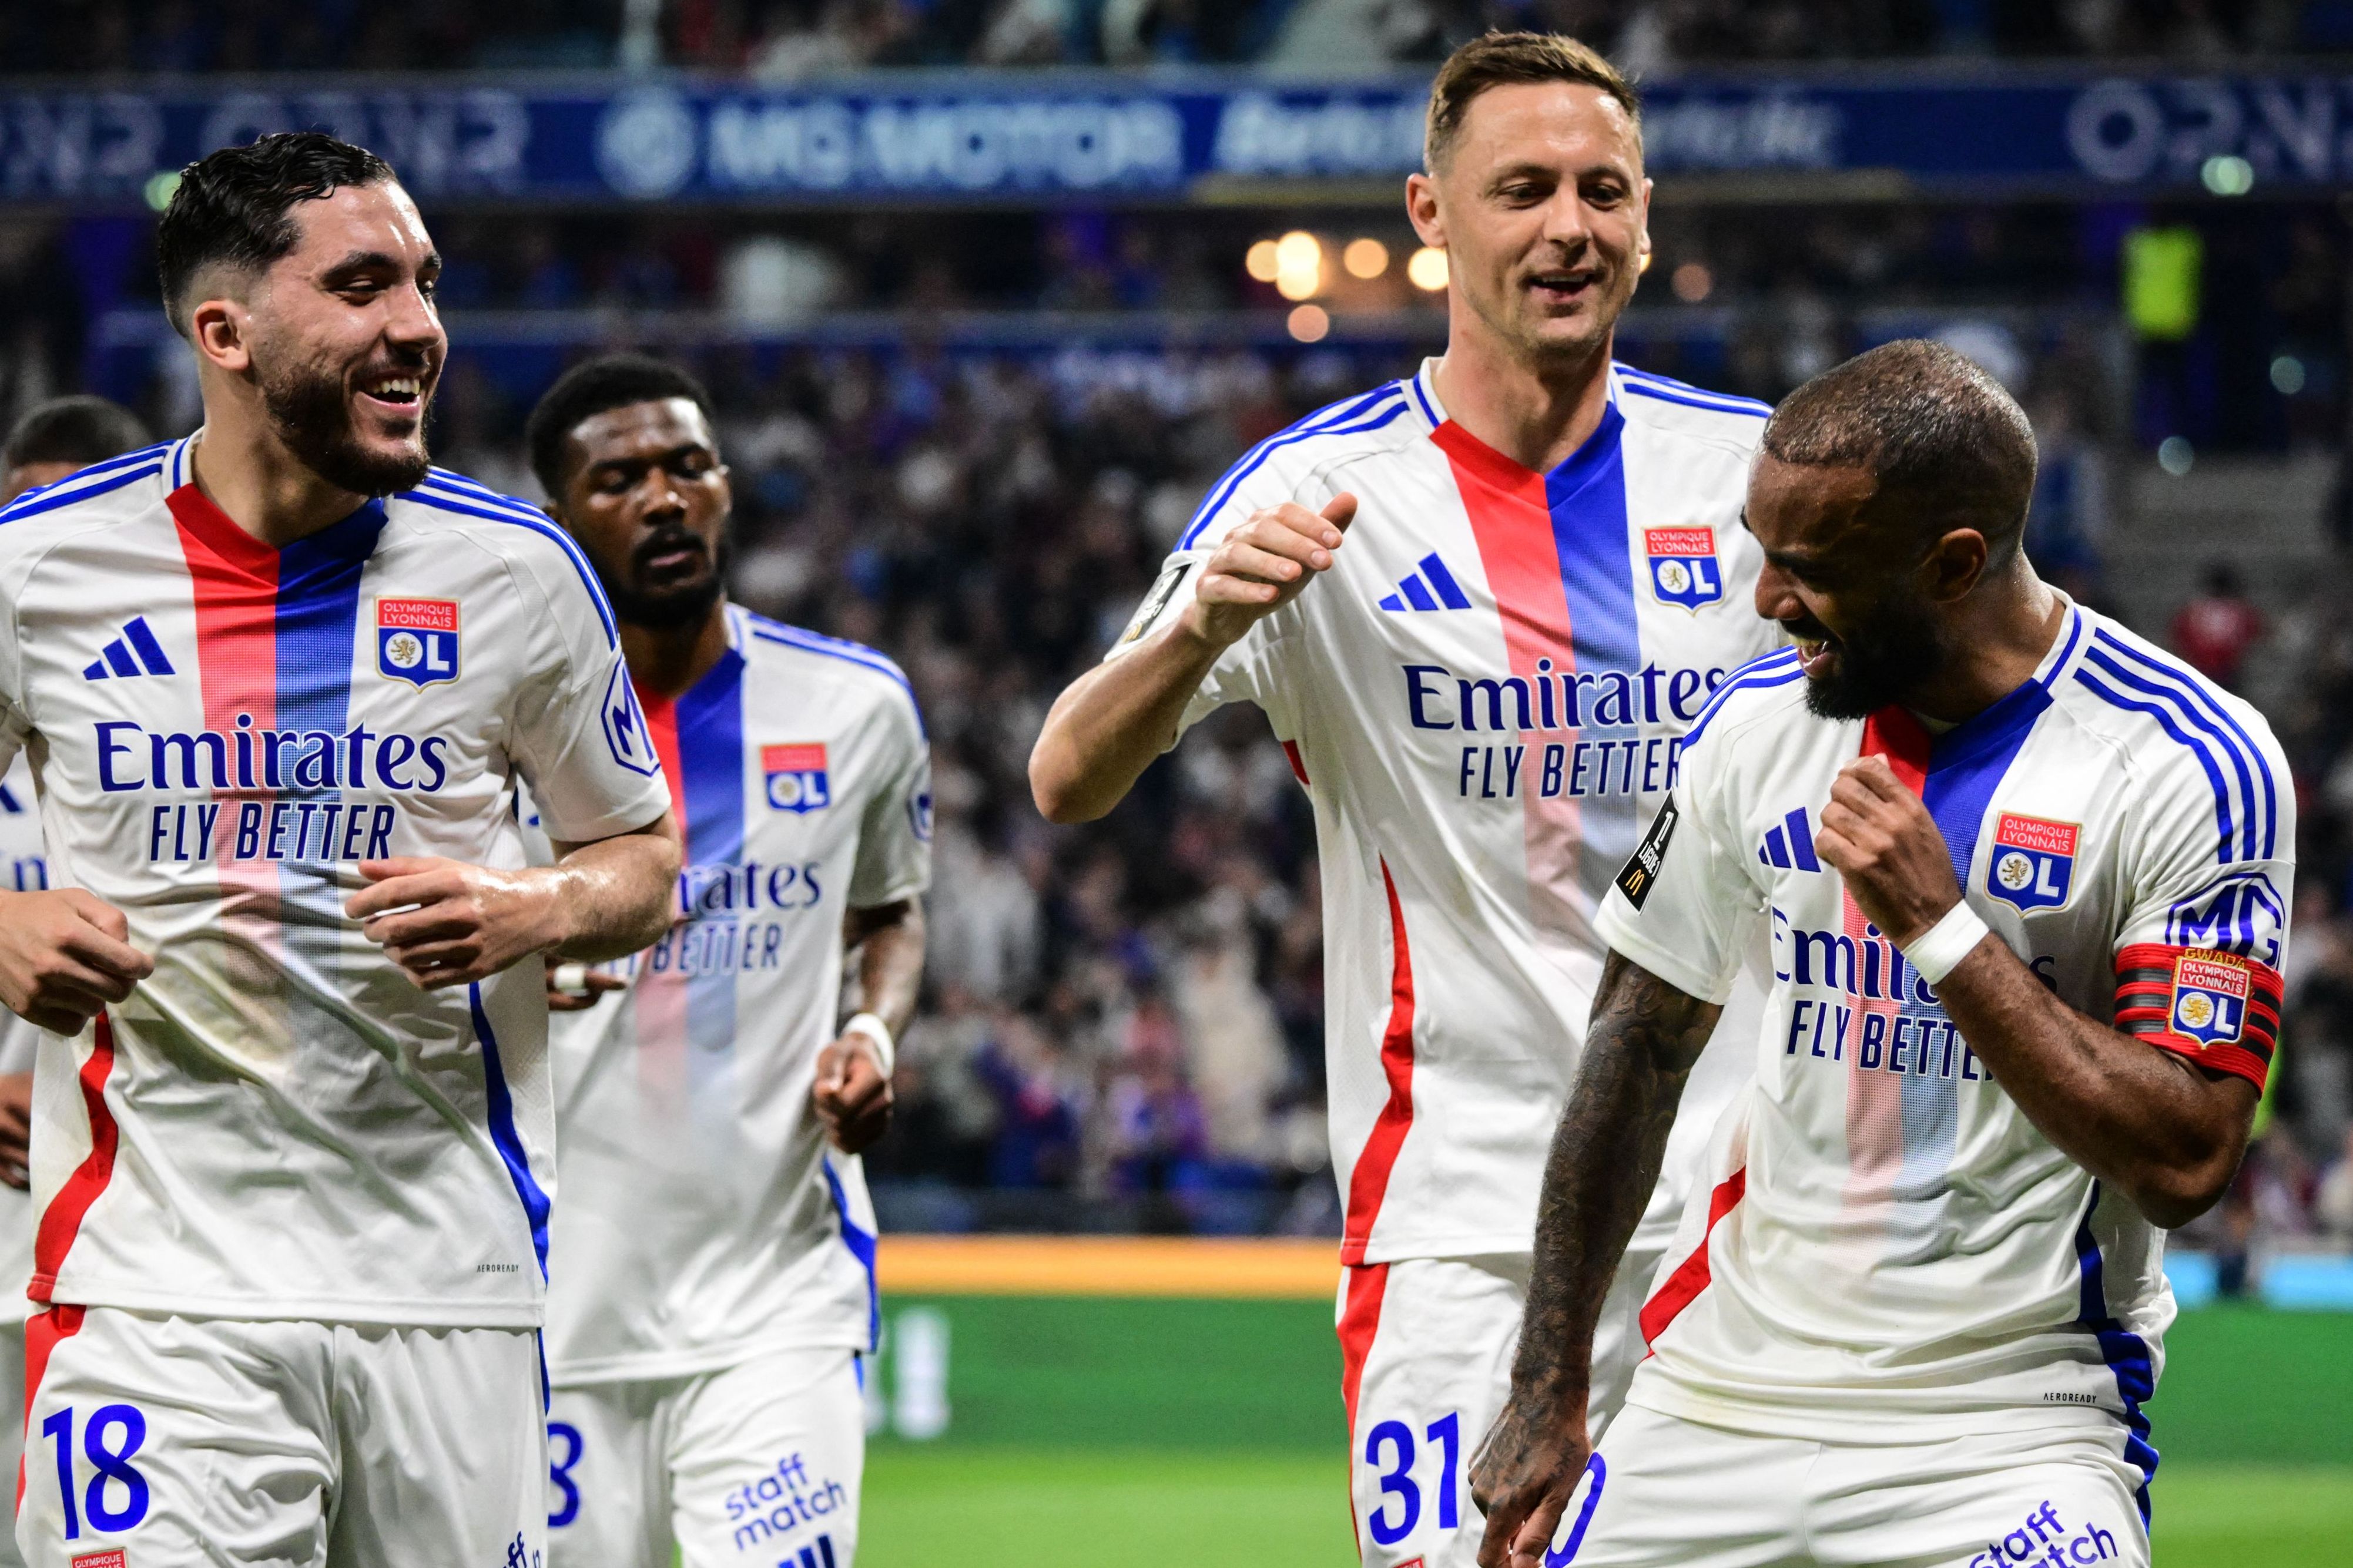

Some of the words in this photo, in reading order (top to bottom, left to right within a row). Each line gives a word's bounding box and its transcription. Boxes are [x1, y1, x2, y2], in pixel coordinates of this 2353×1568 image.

[1649, 532, 1709, 543] OLYMPIQUE
[1651, 542, 1710, 553] LYONNAIS
[1657, 559, 1716, 595] OL
[383, 602, 452, 616] OLYMPIQUE
[383, 613, 452, 627] LYONNAIS
[385, 632, 450, 671] OL
[93, 713, 448, 793] Emirates
[770, 772, 826, 807] OL
[1460, 746, 1524, 798] FLY
[150, 804, 220, 861] FLY
[235, 803, 395, 861] BETTER
[2002, 830, 2070, 851] LYONNAIS
[2005, 818, 2072, 839] OLYMPIQUE
[680, 860, 822, 912] rates
[1996, 851, 2060, 898] OL
[2183, 962, 2245, 983] OLYMPIQUE
[2184, 948, 2245, 970] GWADA
[2181, 973, 2243, 993] LYONNAIS
[1786, 1000, 1852, 1061] FLY
[2177, 992, 2235, 1035] OL
[477, 1264, 519, 1272] AEROREADY
[2043, 1392, 2097, 1404] AEROREADY
[43, 1404, 149, 1540] 18
[726, 1453, 808, 1520] staff
[1365, 1411, 1459, 1546] 31
[735, 1478, 847, 1550] match
[74, 1553, 122, 1568] OLYMPIQUE
